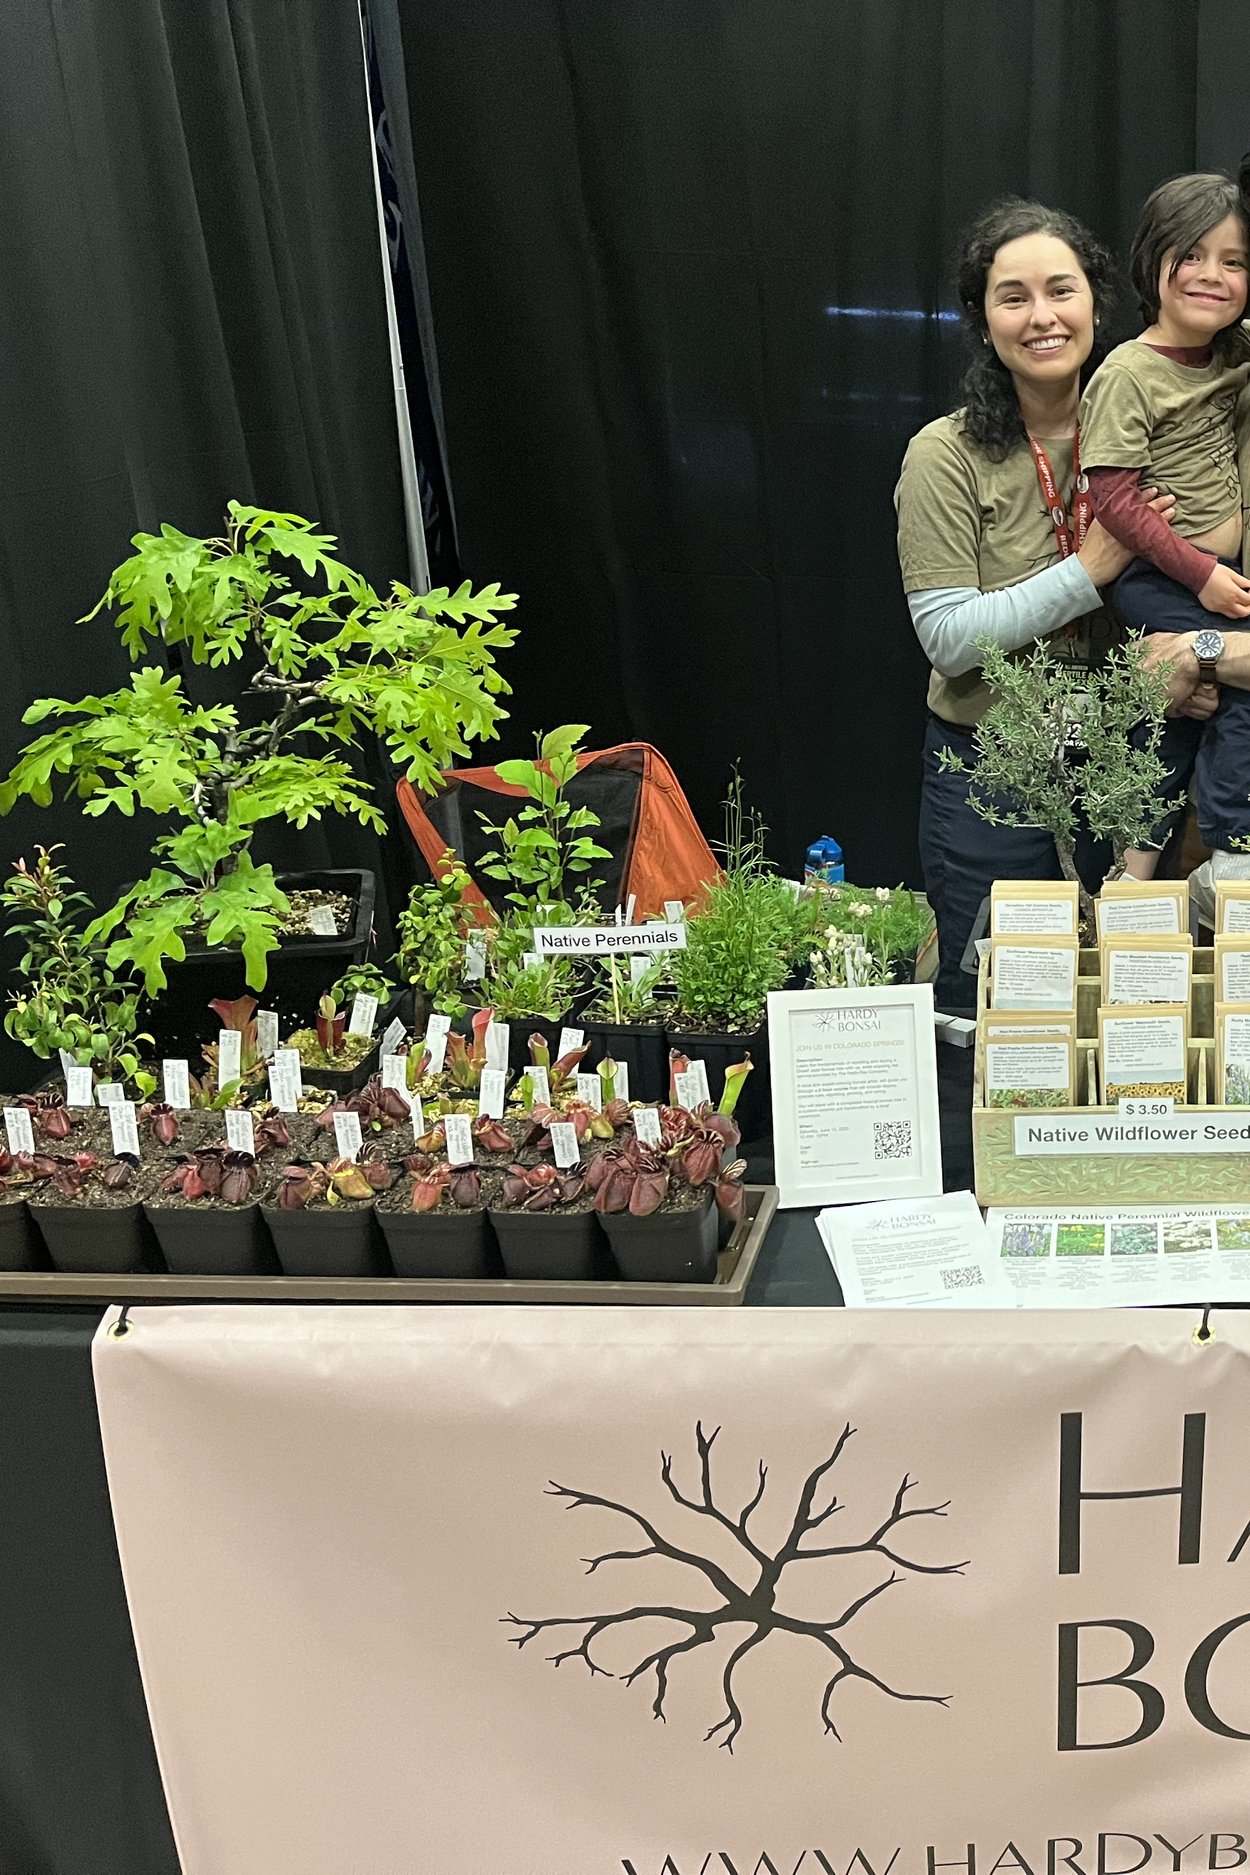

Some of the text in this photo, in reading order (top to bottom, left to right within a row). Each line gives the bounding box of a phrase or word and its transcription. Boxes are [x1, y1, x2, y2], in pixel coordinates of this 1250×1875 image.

[1038, 455, 1056, 499] SHIPPING
[540, 930, 678, 947] Native Perennials
[837, 1008, 880, 1020] HARDY
[838, 1020, 881, 1032] BONSAI
[1125, 1103, 1168, 1115] $ 3.50
[1028, 1127, 1089, 1143] Native
[1095, 1125, 1198, 1142] Wildflower
[1118, 1211, 1180, 1220] Perennial
